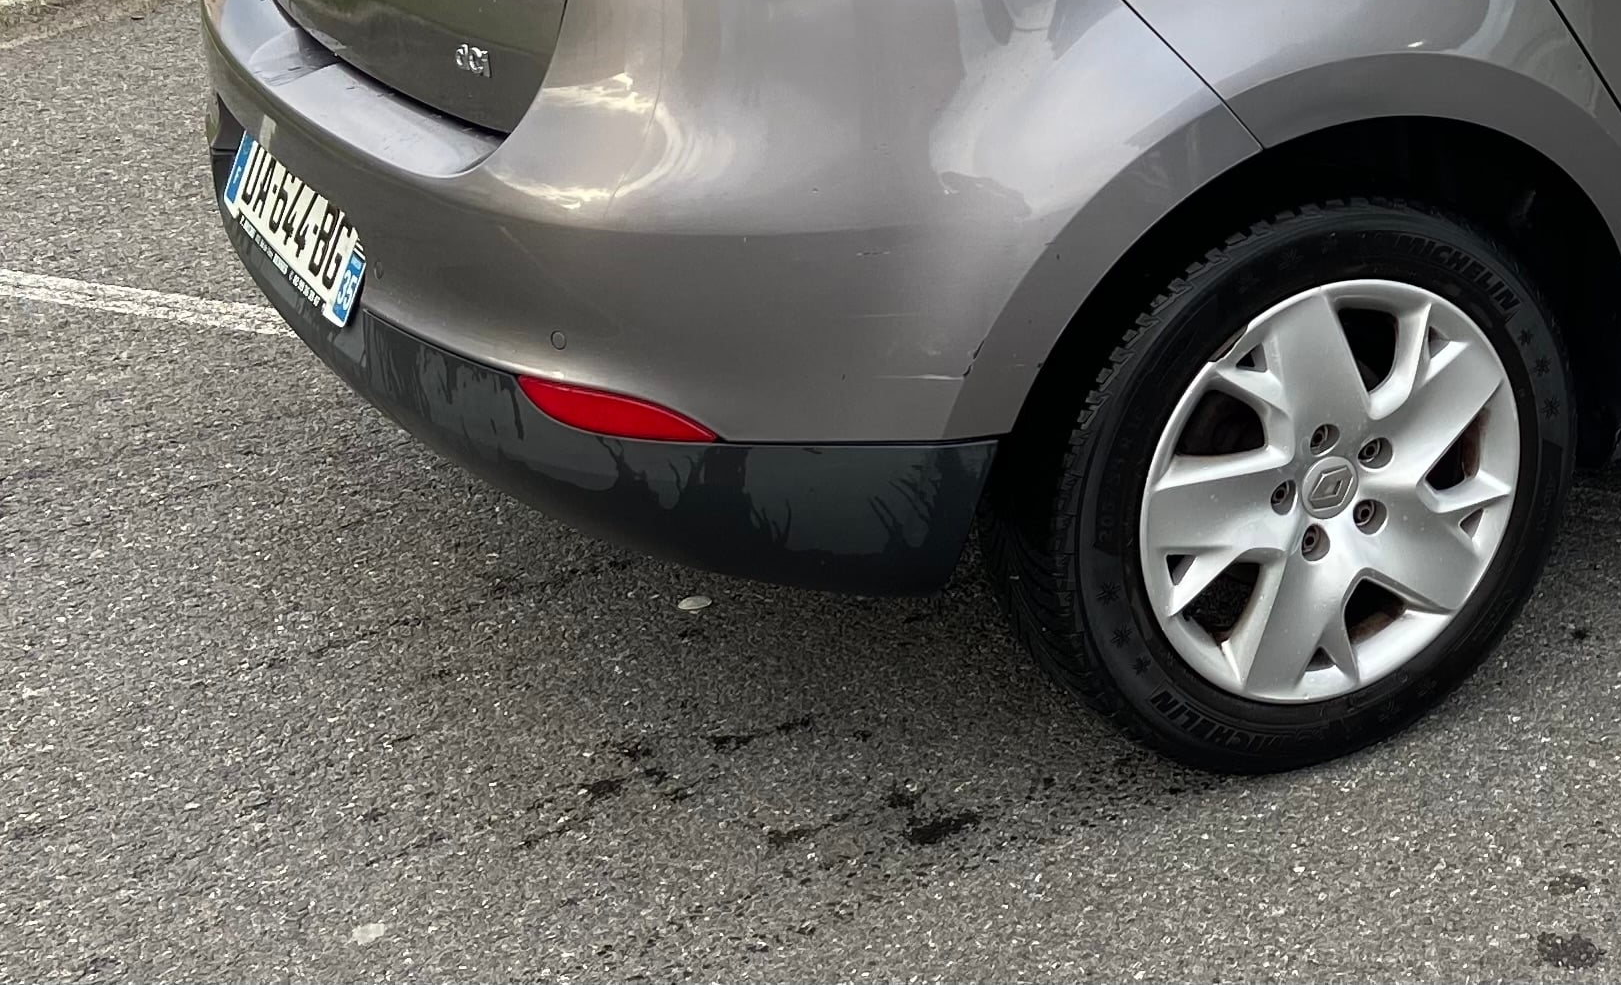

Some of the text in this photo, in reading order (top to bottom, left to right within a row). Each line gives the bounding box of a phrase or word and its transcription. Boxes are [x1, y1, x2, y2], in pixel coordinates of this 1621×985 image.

[241, 145, 355, 290] DA-644-BG
[336, 269, 359, 312] 35
[1396, 235, 1521, 312] MICHELIN
[1151, 690, 1283, 752] MICHELIN
